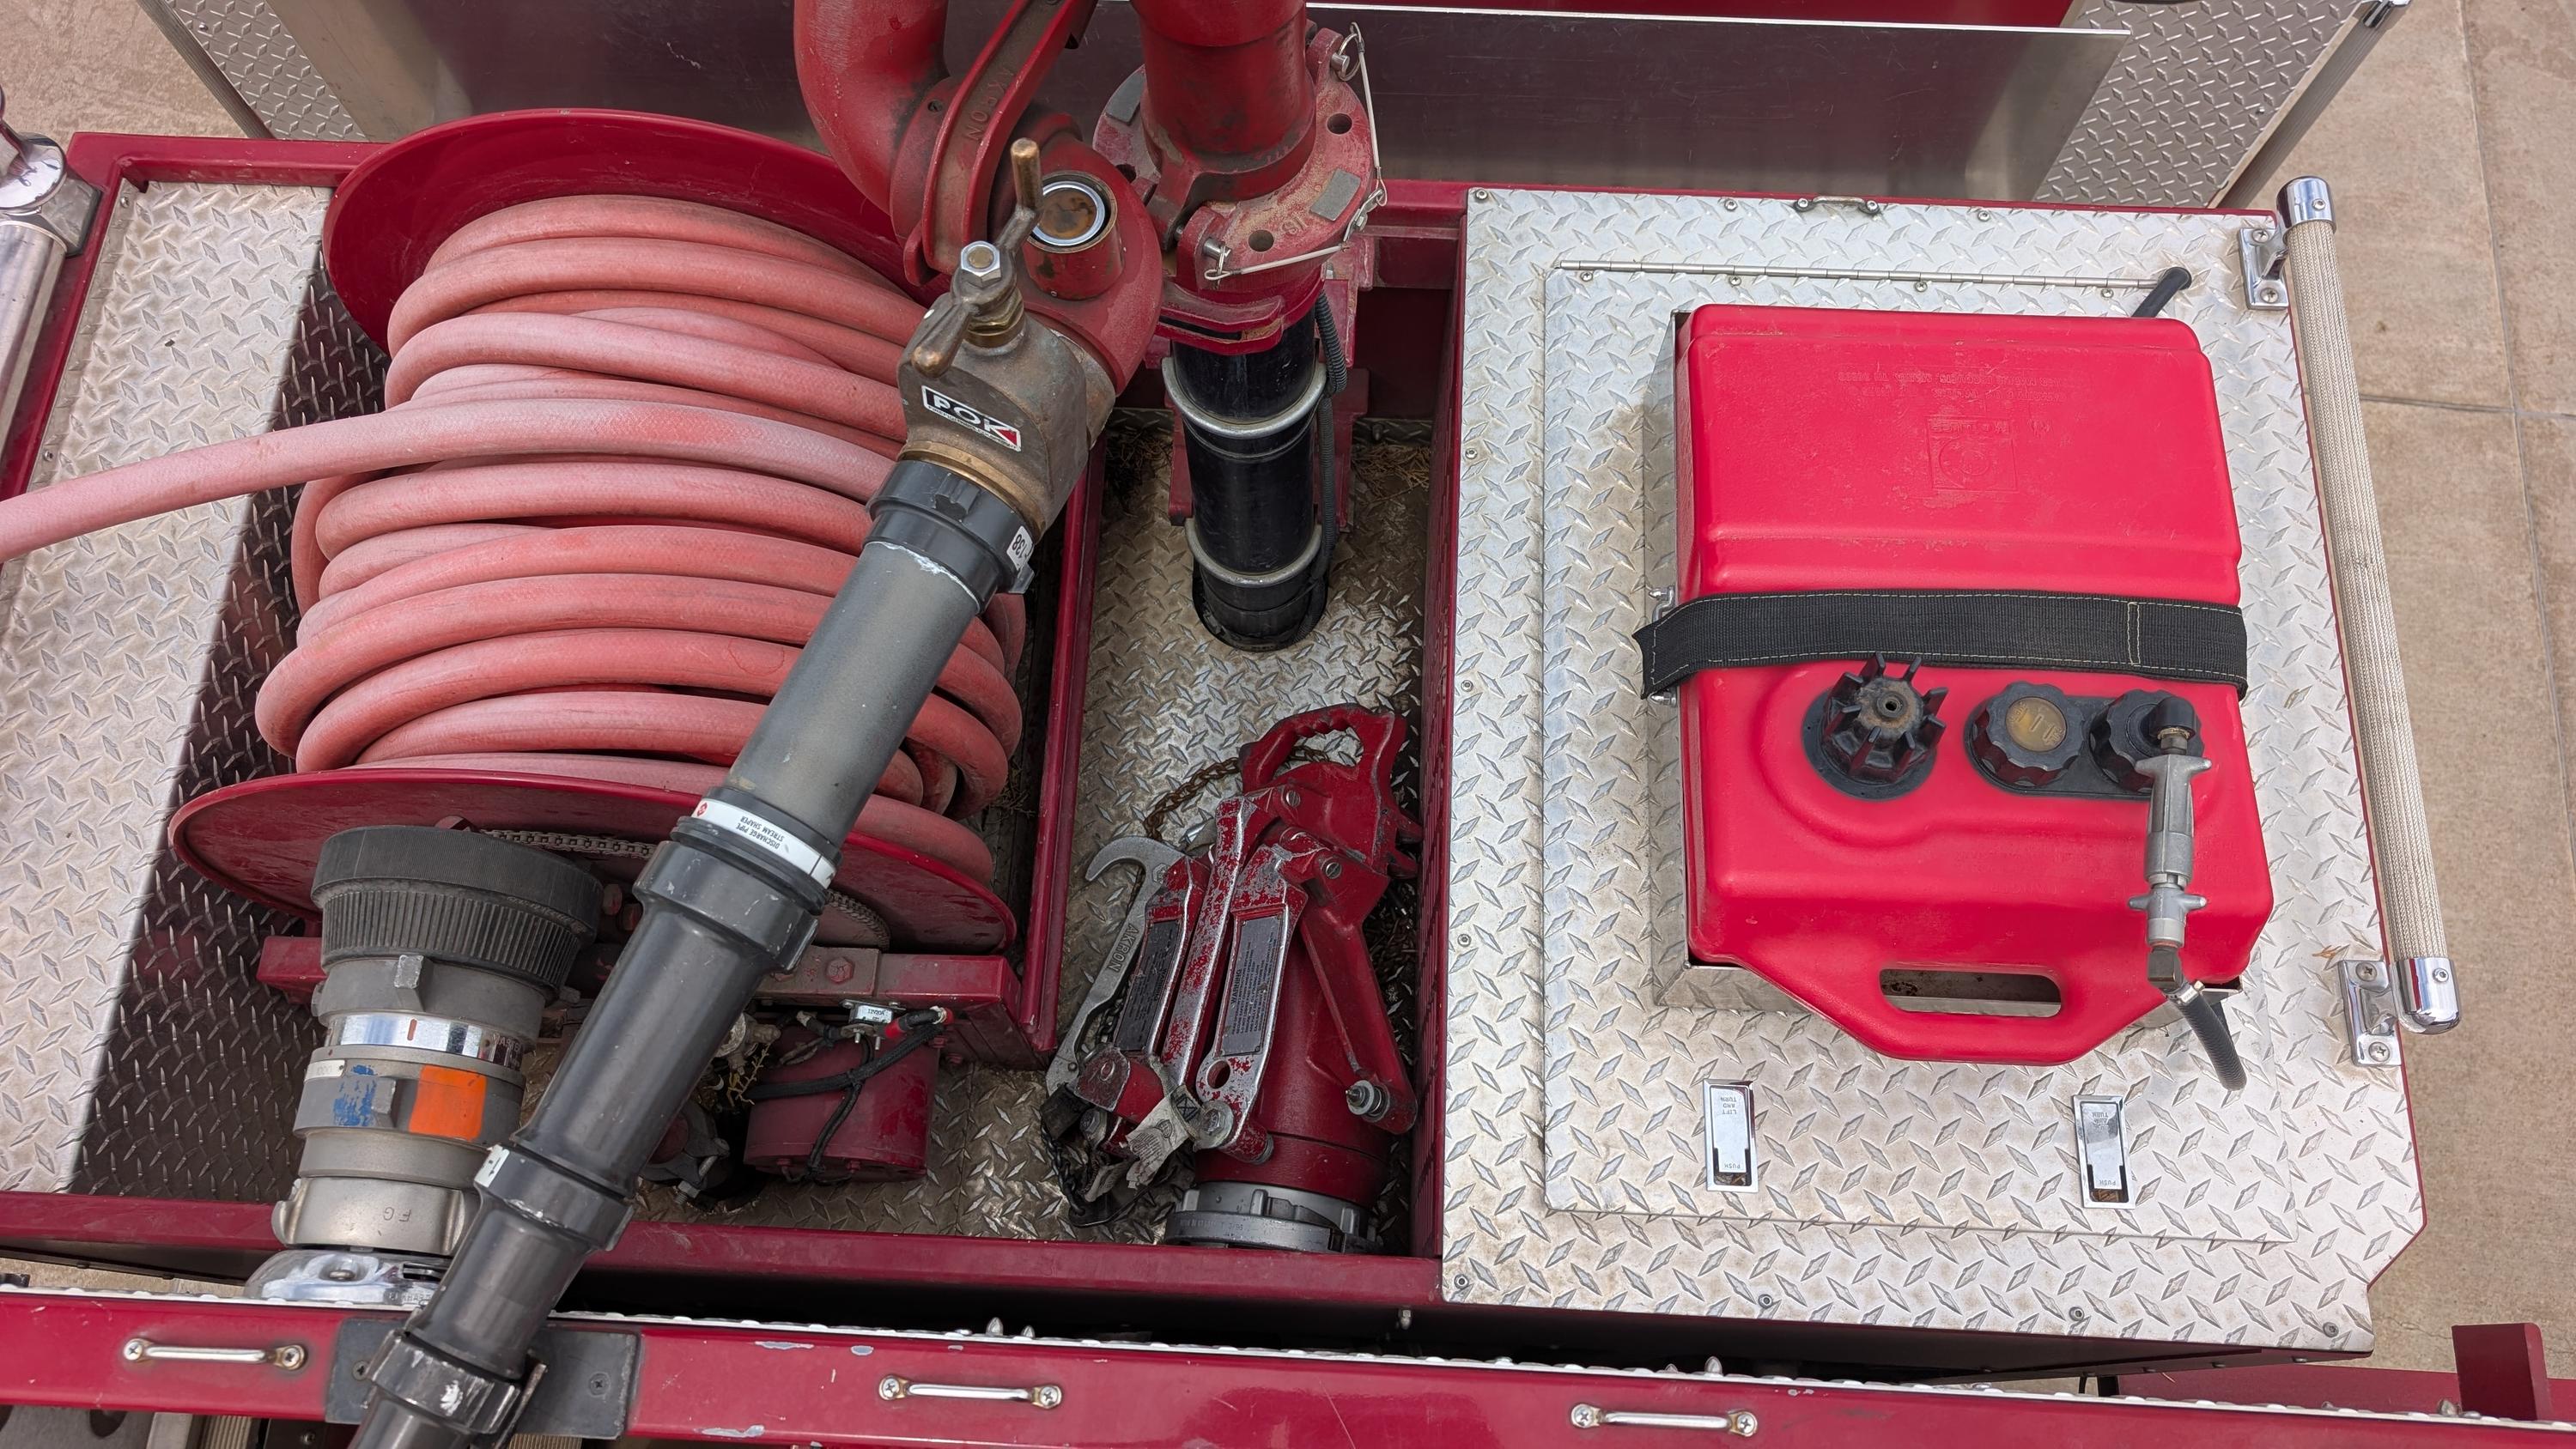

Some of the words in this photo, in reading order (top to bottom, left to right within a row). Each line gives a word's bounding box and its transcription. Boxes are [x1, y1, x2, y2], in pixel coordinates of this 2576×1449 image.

[933, 394, 1017, 445] POK
[735, 822, 748, 834] PIPE
[739, 815, 762, 830] SHAPER
[749, 828, 781, 849] DISCHARGE
[762, 827, 786, 843] STREAM
[1108, 924, 1138, 973] AKRON
[1230, 968, 1241, 1003] WARNING
